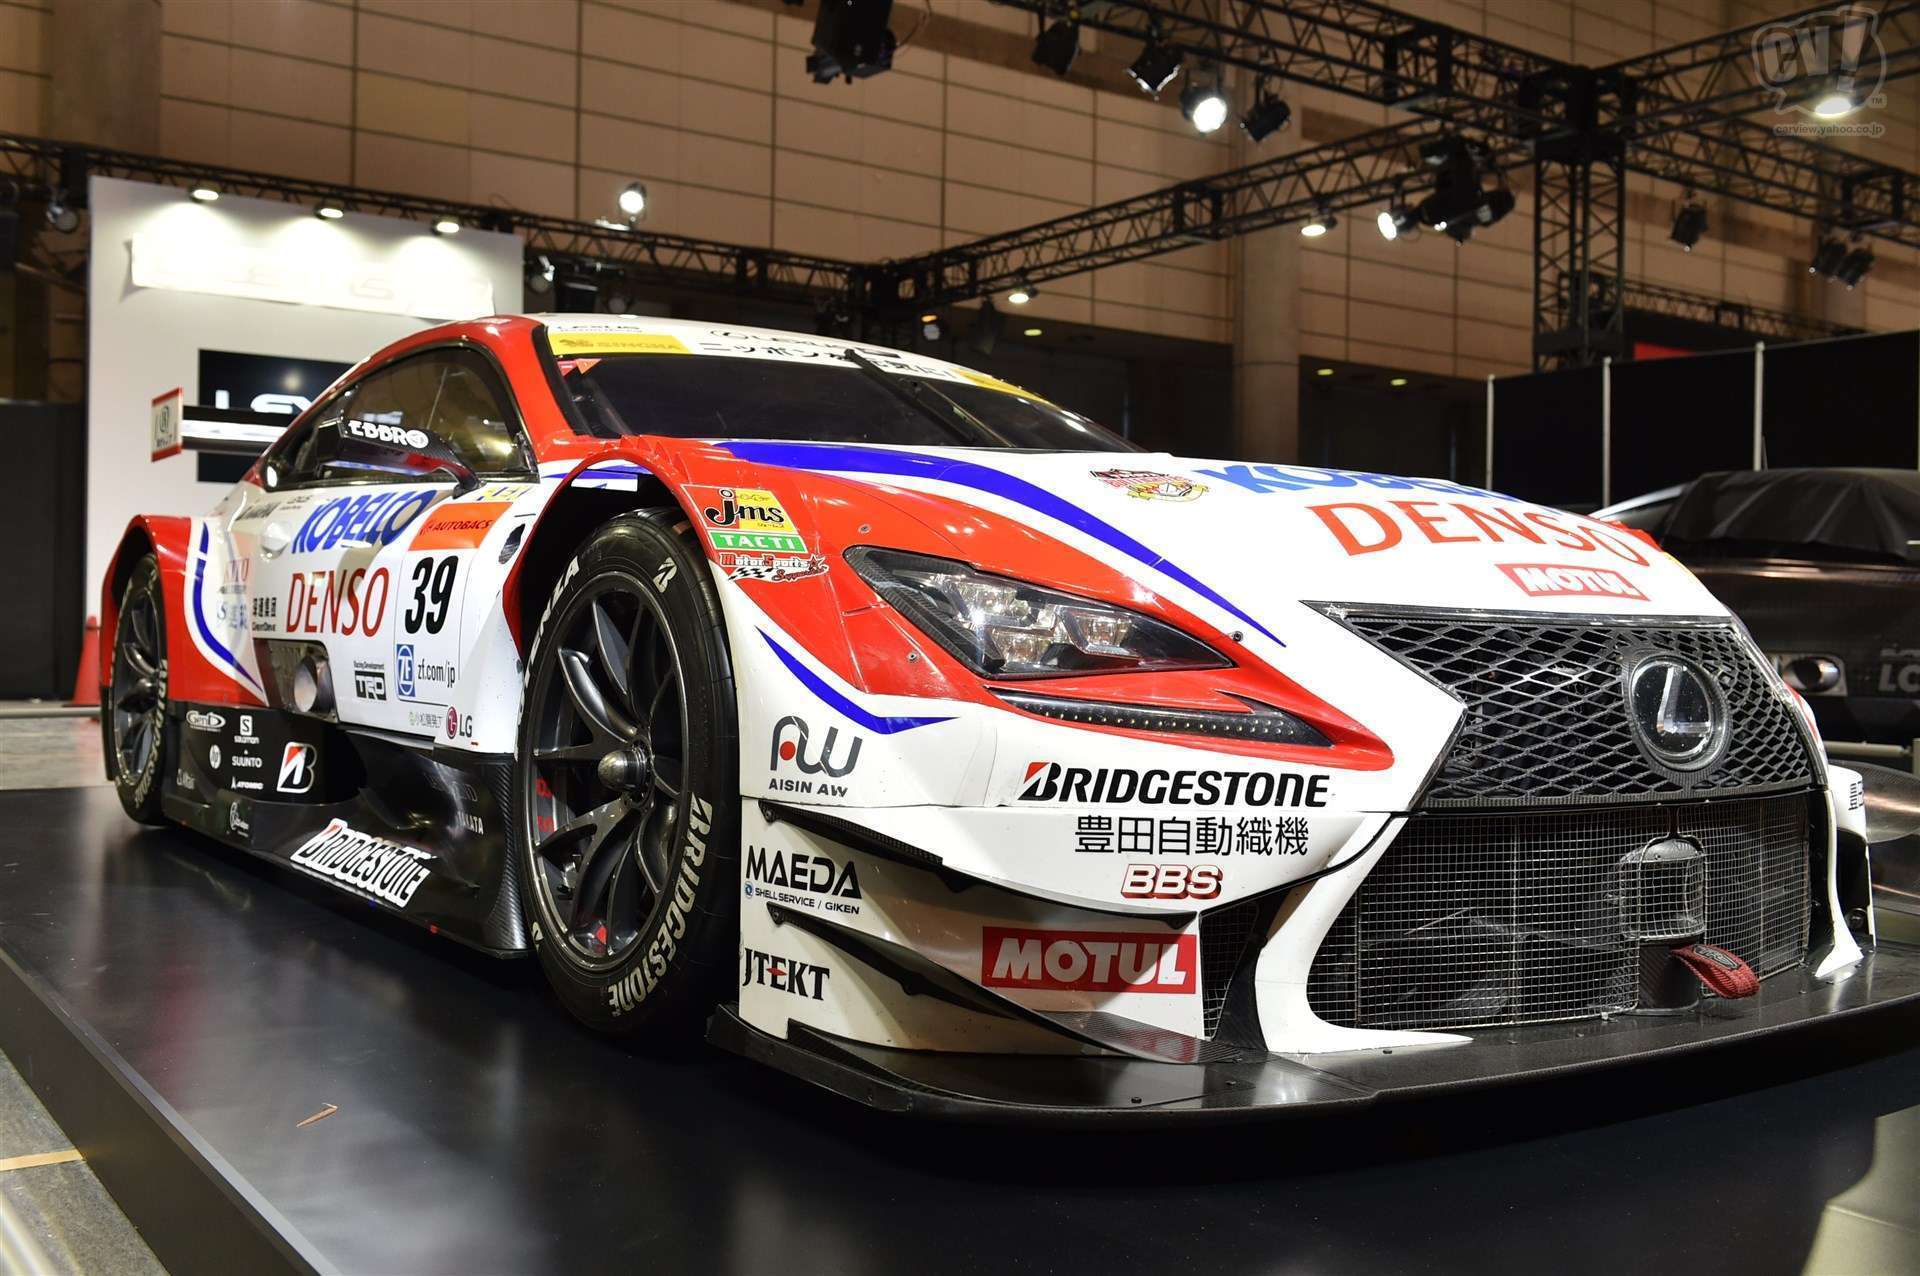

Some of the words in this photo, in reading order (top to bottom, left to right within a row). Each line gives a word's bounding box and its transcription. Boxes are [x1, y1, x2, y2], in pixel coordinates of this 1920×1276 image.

[291, 489, 437, 554] KOBELCO
[432, 519, 494, 532] AUTOBACS
[704, 489, 785, 526] jms
[719, 534, 796, 550] TACTI
[1305, 499, 1650, 567] DENSO
[285, 566, 390, 638] DENSO
[404, 555, 459, 636] 39
[1525, 567, 1637, 597] MOTUL
[417, 658, 456, 688] zf.com/jp
[459, 713, 473, 739] LG
[231, 755, 263, 768] SUUNTO
[768, 777, 813, 794] AISIN
[816, 783, 849, 798] AW
[1017, 761, 1330, 808] BRIDGESTONE
[1074, 814, 1310, 857] 豊田自動織機
[291, 818, 431, 908] BRIDGESTONE
[745, 845, 863, 901] MAEDA
[1120, 863, 1224, 900] BBS
[608, 791, 713, 1011] BRIDGESTONE
[754, 886, 779, 901] SHELL
[778, 890, 815, 909] SERVICE
[825, 900, 861, 915] GIKEN
[742, 947, 831, 1002] JTEKT
[991, 937, 1187, 986] MOTUL
